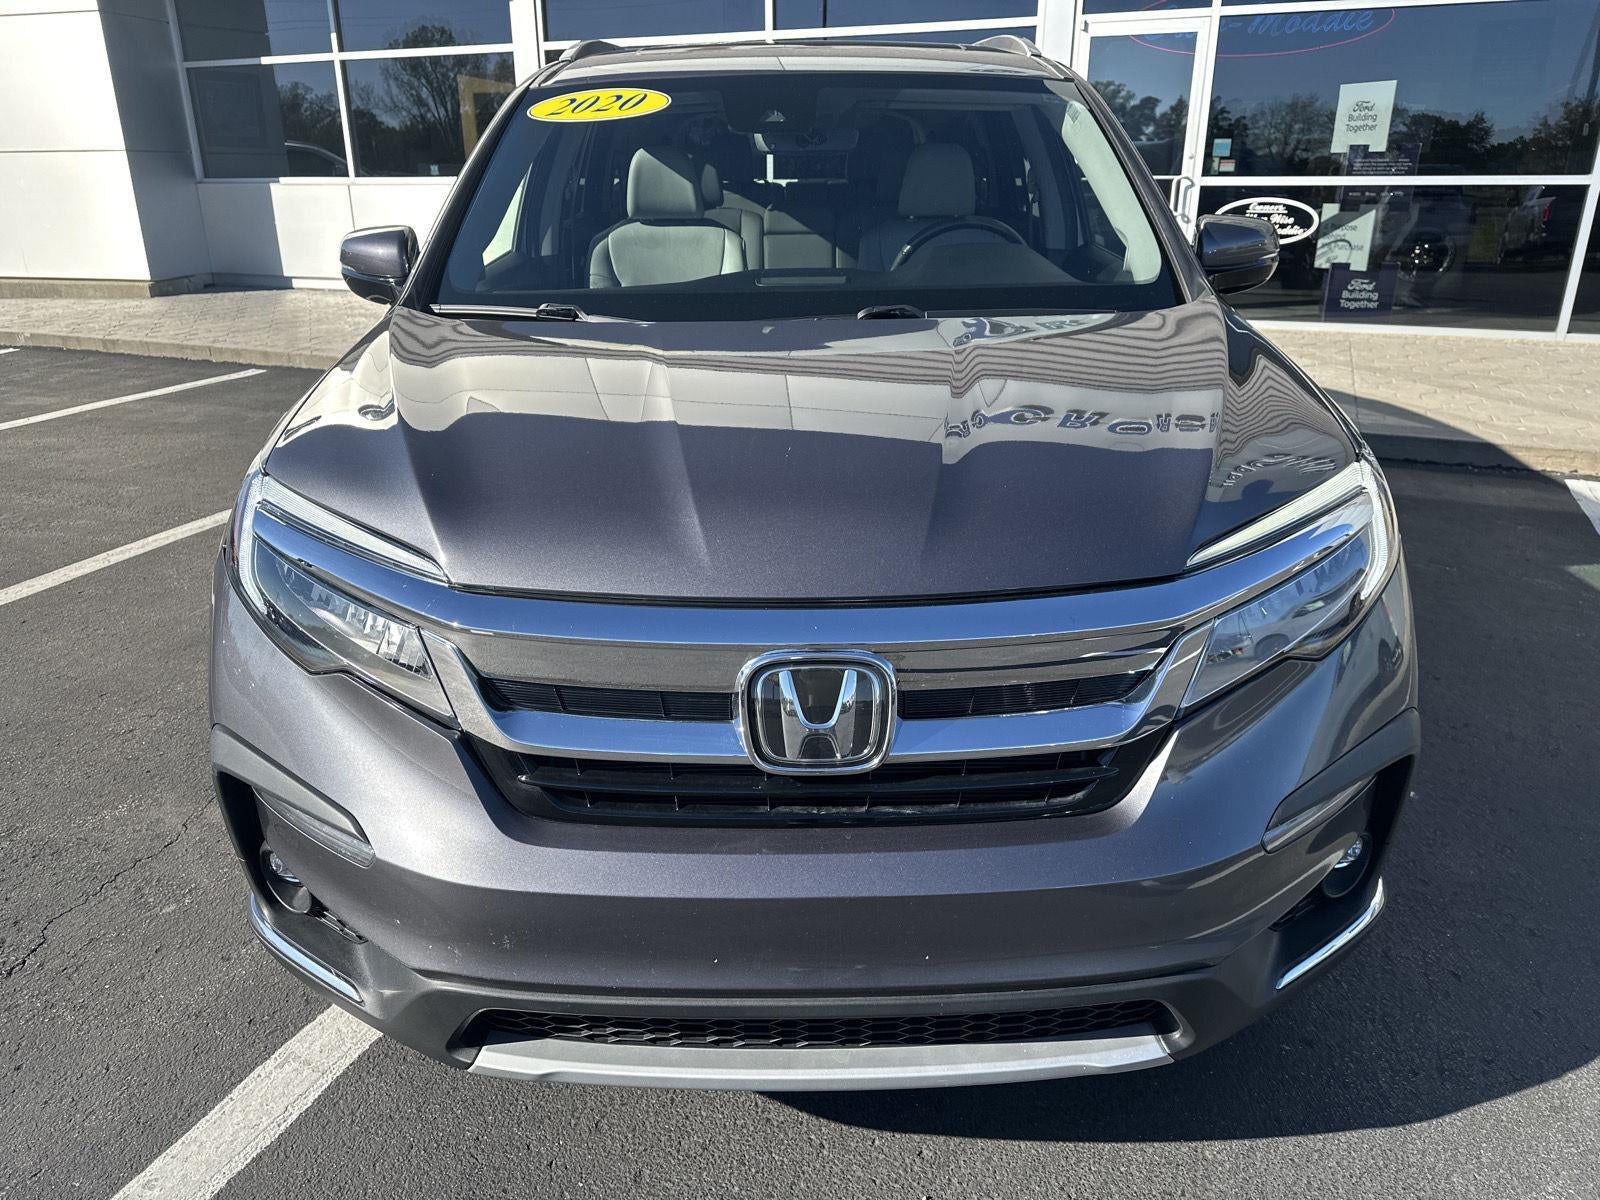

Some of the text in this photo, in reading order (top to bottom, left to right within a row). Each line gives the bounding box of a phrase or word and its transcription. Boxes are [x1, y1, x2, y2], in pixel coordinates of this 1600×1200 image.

[545, 93, 647, 116] 2020
[1352, 100, 1376, 112] Ford
[1347, 113, 1378, 122] Building
[1345, 123, 1378, 133] Together
[1347, 279, 1376, 290] Ford
[1341, 290, 1379, 300] Building
[1340, 300, 1380, 310] Together
